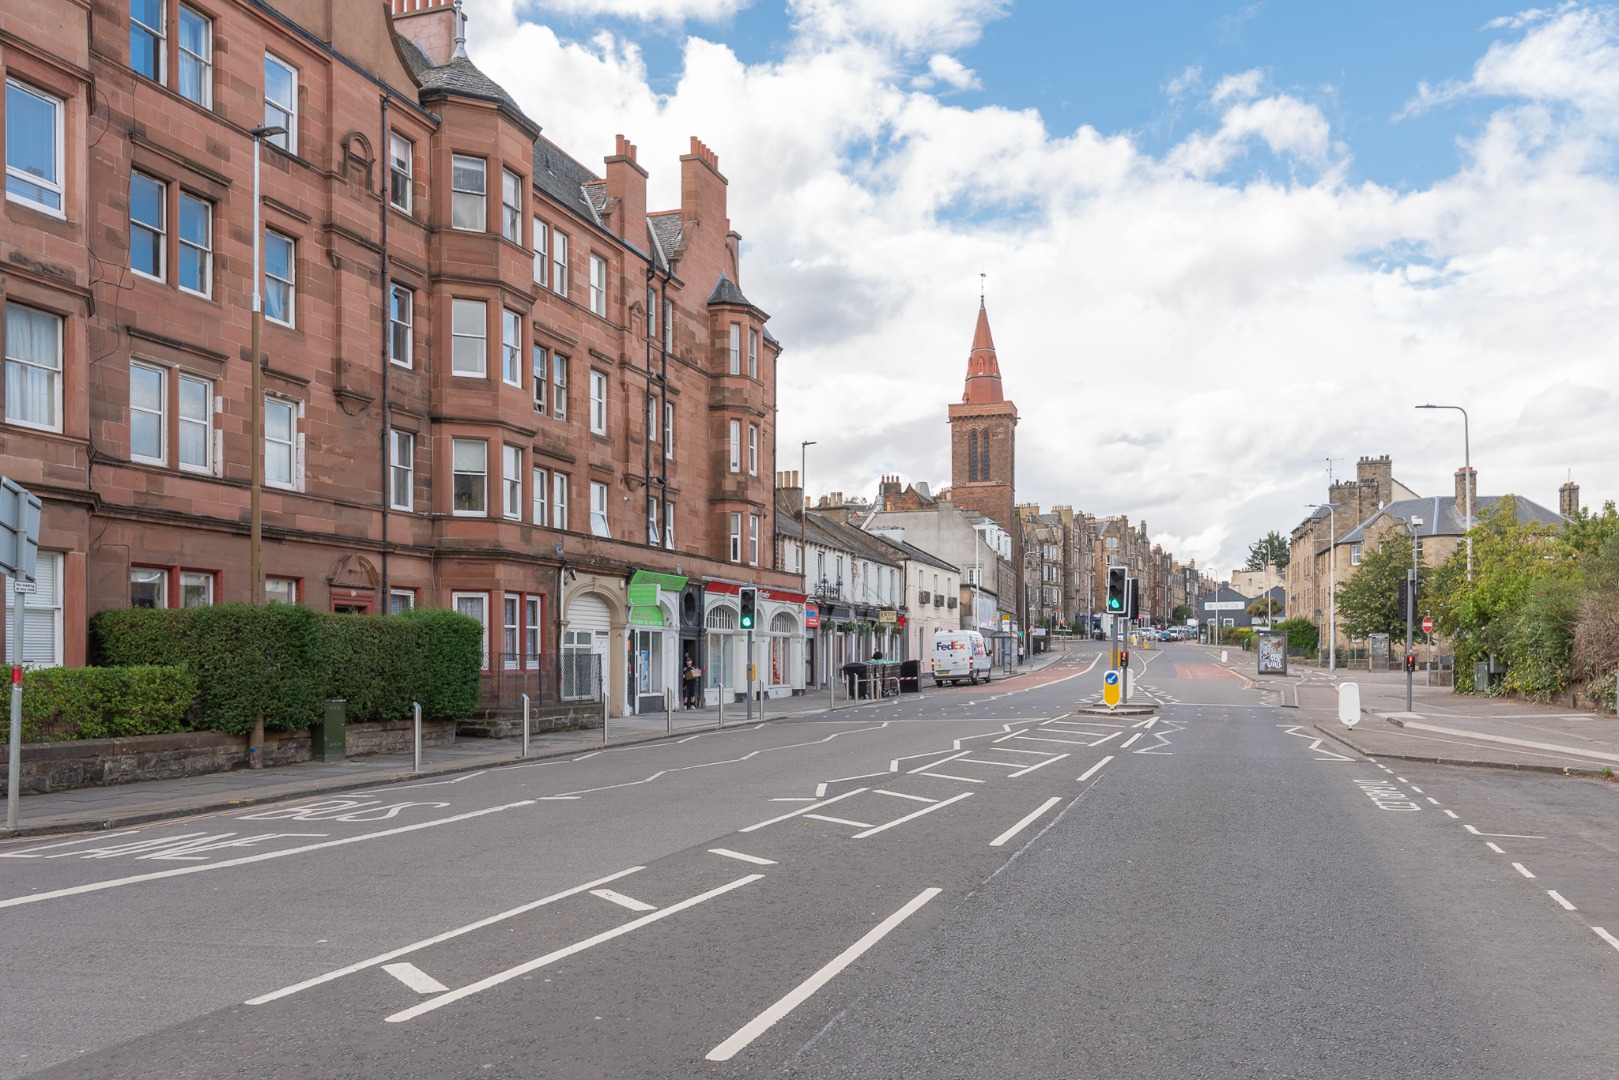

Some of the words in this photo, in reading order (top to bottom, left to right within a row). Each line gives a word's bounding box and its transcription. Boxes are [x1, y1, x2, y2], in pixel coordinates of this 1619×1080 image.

[936, 641, 966, 651] FedEx
[233, 800, 450, 822] BUS
[0, 830, 330, 860] LANE
